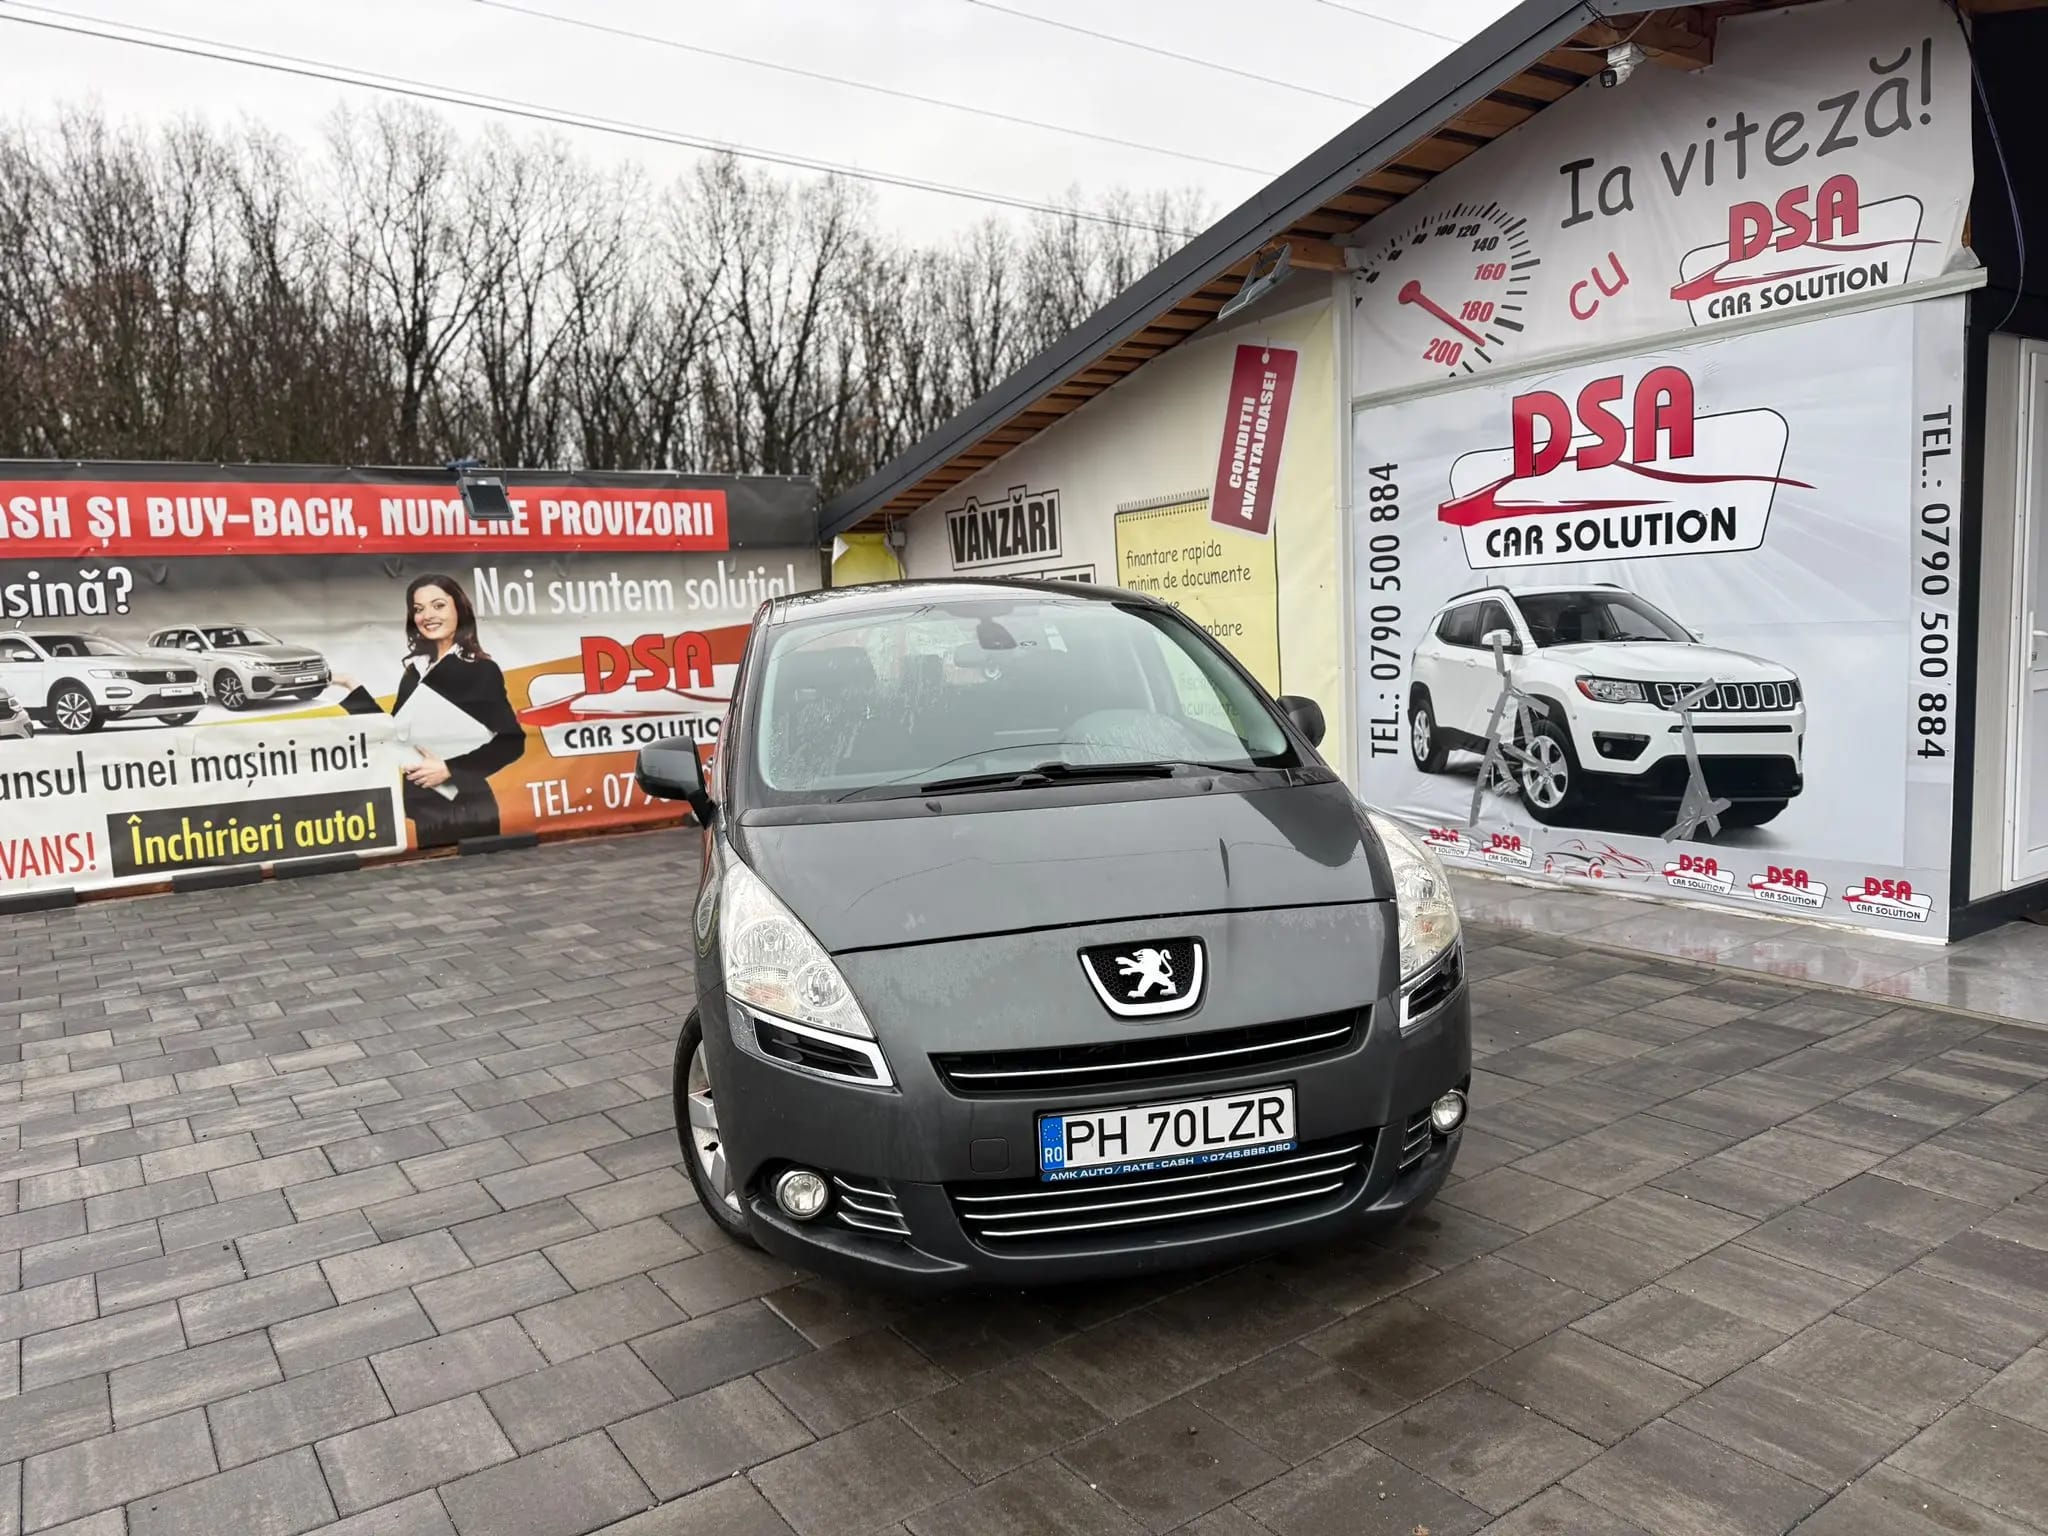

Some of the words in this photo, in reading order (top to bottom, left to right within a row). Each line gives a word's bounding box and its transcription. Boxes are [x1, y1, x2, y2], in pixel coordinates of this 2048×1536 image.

[1559, 157, 1634, 229] Ia
[1660, 37, 1932, 197] viteză!
[1456, 224, 1480, 238] 120
[1472, 236, 1499, 252] 140
[1729, 173, 1859, 263] DSA
[1474, 262, 1506, 281] 160
[1569, 251, 1630, 320] cu
[1708, 288, 1752, 319] CAR
[1760, 261, 1888, 310] SOLUTION
[1460, 300, 1494, 322] 180
[1422, 337, 1463, 367] 200
[1229, 396, 1256, 489] CONDITII
[1241, 371, 1277, 520] AVANTAJOASE!
[1512, 365, 1695, 479] DSA
[1920, 404, 1952, 489] TEL.:
[146, 496, 368, 540] BUY-BACK,
[541, 500, 714, 536] PROVIZORII
[1368, 462, 1400, 525] 884
[950, 493, 1058, 564] VÂNZĂRI
[1126, 549, 1179, 569] finantare
[1182, 538, 1222, 564] rapida
[1486, 524, 1544, 558] CAR
[1556, 506, 1737, 552] SOLUTION
[1920, 502, 1951, 597] 0790
[1128, 575, 1160, 592] minim
[1163, 570, 1179, 589] de
[1182, 564, 1252, 587] documente
[1369, 535, 1401, 592] 500
[0, 565, 134, 630] șină?
[473, 567, 536, 616] Noi
[548, 571, 674, 616] suntem
[580, 631, 715, 695] DSA
[1370, 605, 1401, 683] 0790
[1919, 612, 1949, 679] 500
[564, 725, 613, 749] CAR
[622, 717, 722, 745] SOLUTIO
[1371, 693, 1399, 759] TEL.:
[1917, 691, 1947, 760] 884
[101, 748, 177, 791] unei
[191, 739, 298, 788] mașini
[310, 732, 369, 773] noi!
[526, 778, 593, 818] TEL.:
[0, 831, 97, 881] VANS!
[127, 814, 284, 867] Închirieri
[295, 802, 377, 848] auto!
[1491, 833, 1521, 851] DSA
[1680, 854, 1718, 876] DSA
[1672, 878, 1686, 887] CAR
[1688, 880, 1726, 893] SOLUTION
[1760, 891, 1775, 900] CAR
[1777, 893, 1818, 906] SOLUTION
[1767, 865, 1808, 889] DSA
[1864, 876, 1912, 901] DSA
[1856, 903, 1873, 913] CAR
[1876, 907, 1921, 920] SOLUTION
[1044, 1145, 1063, 1164] RO
[1065, 1115, 1128, 1161] PH
[1050, 1171, 1078, 1181] AMK
